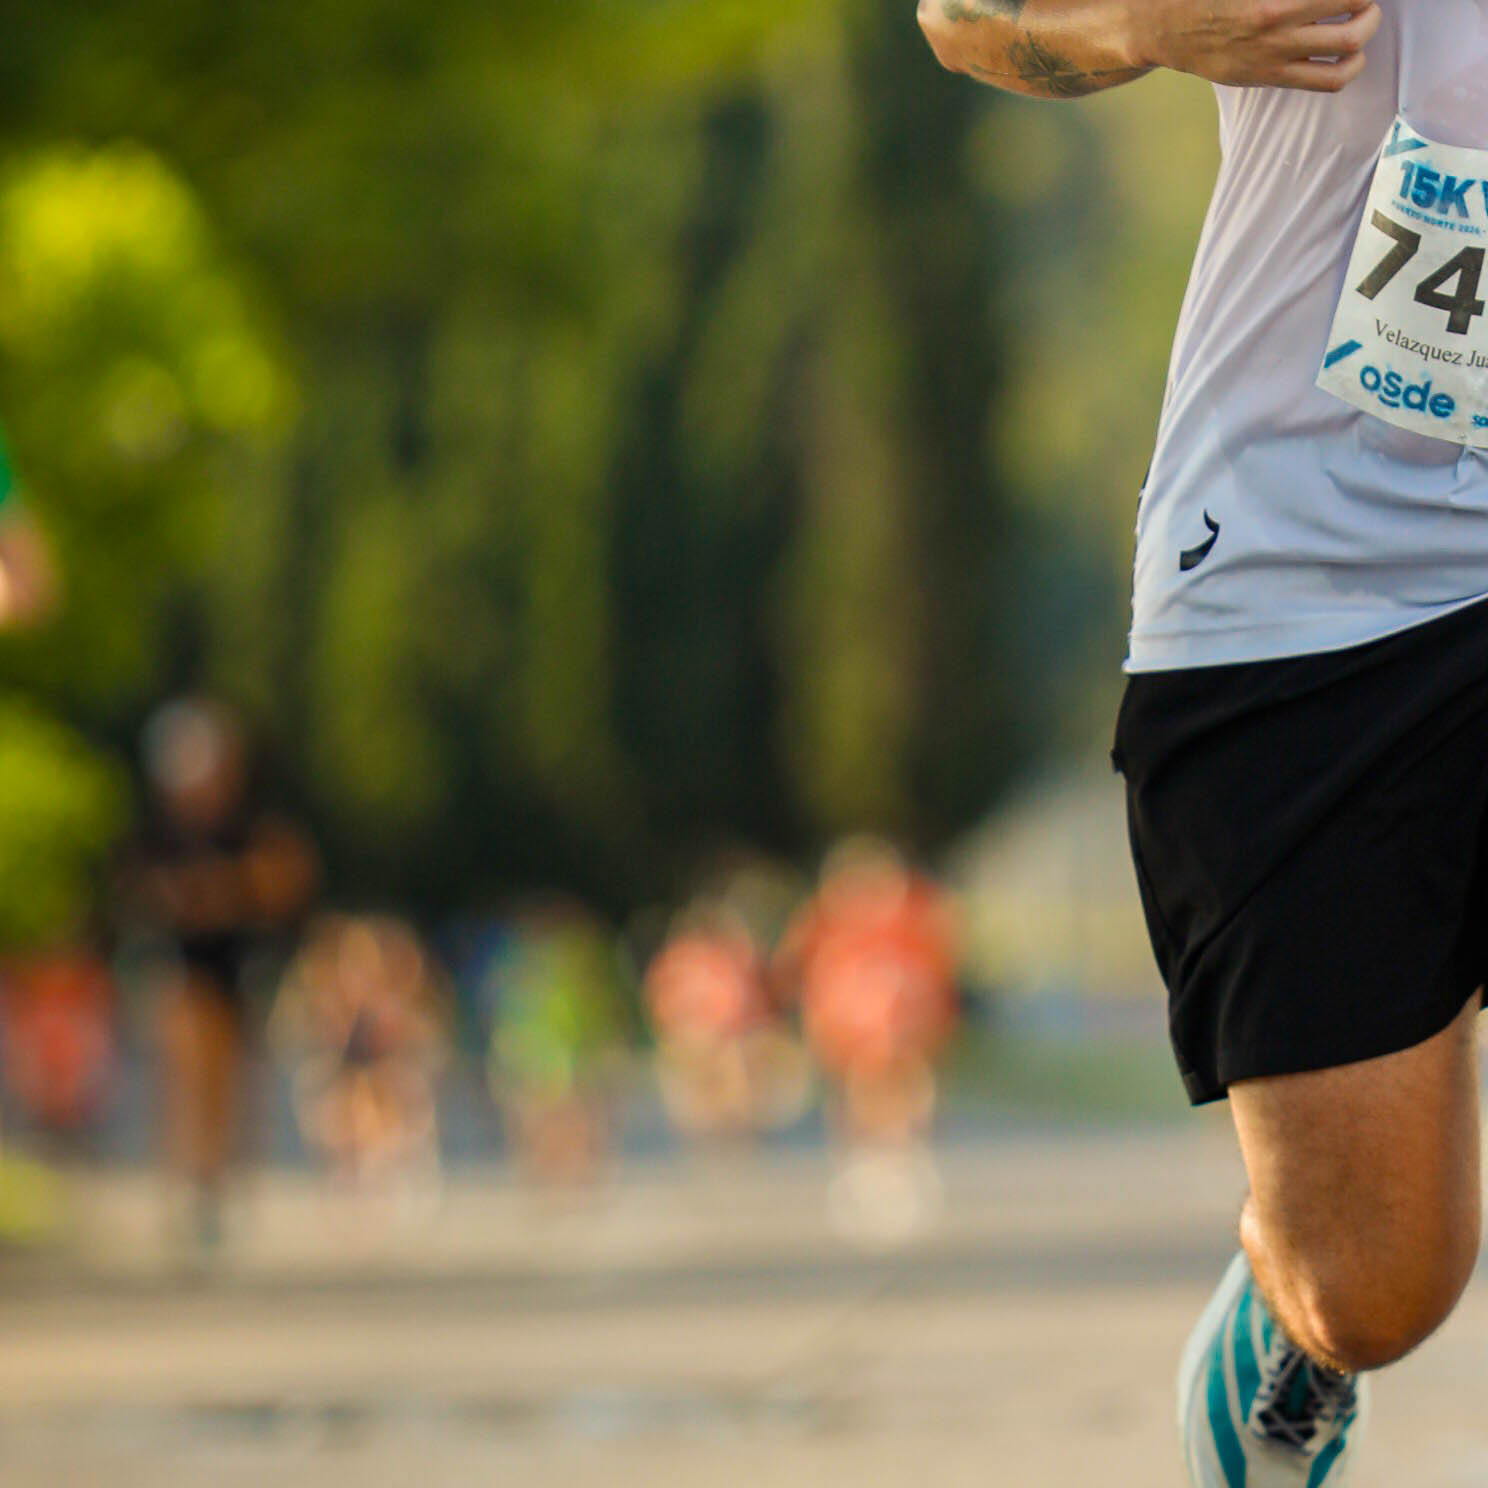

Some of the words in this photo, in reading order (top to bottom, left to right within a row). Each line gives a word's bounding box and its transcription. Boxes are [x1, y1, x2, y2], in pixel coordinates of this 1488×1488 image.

[1400, 159, 1477, 218] 15K
[1375, 318, 1463, 365] Velazquez
[1359, 365, 1456, 419] osde
